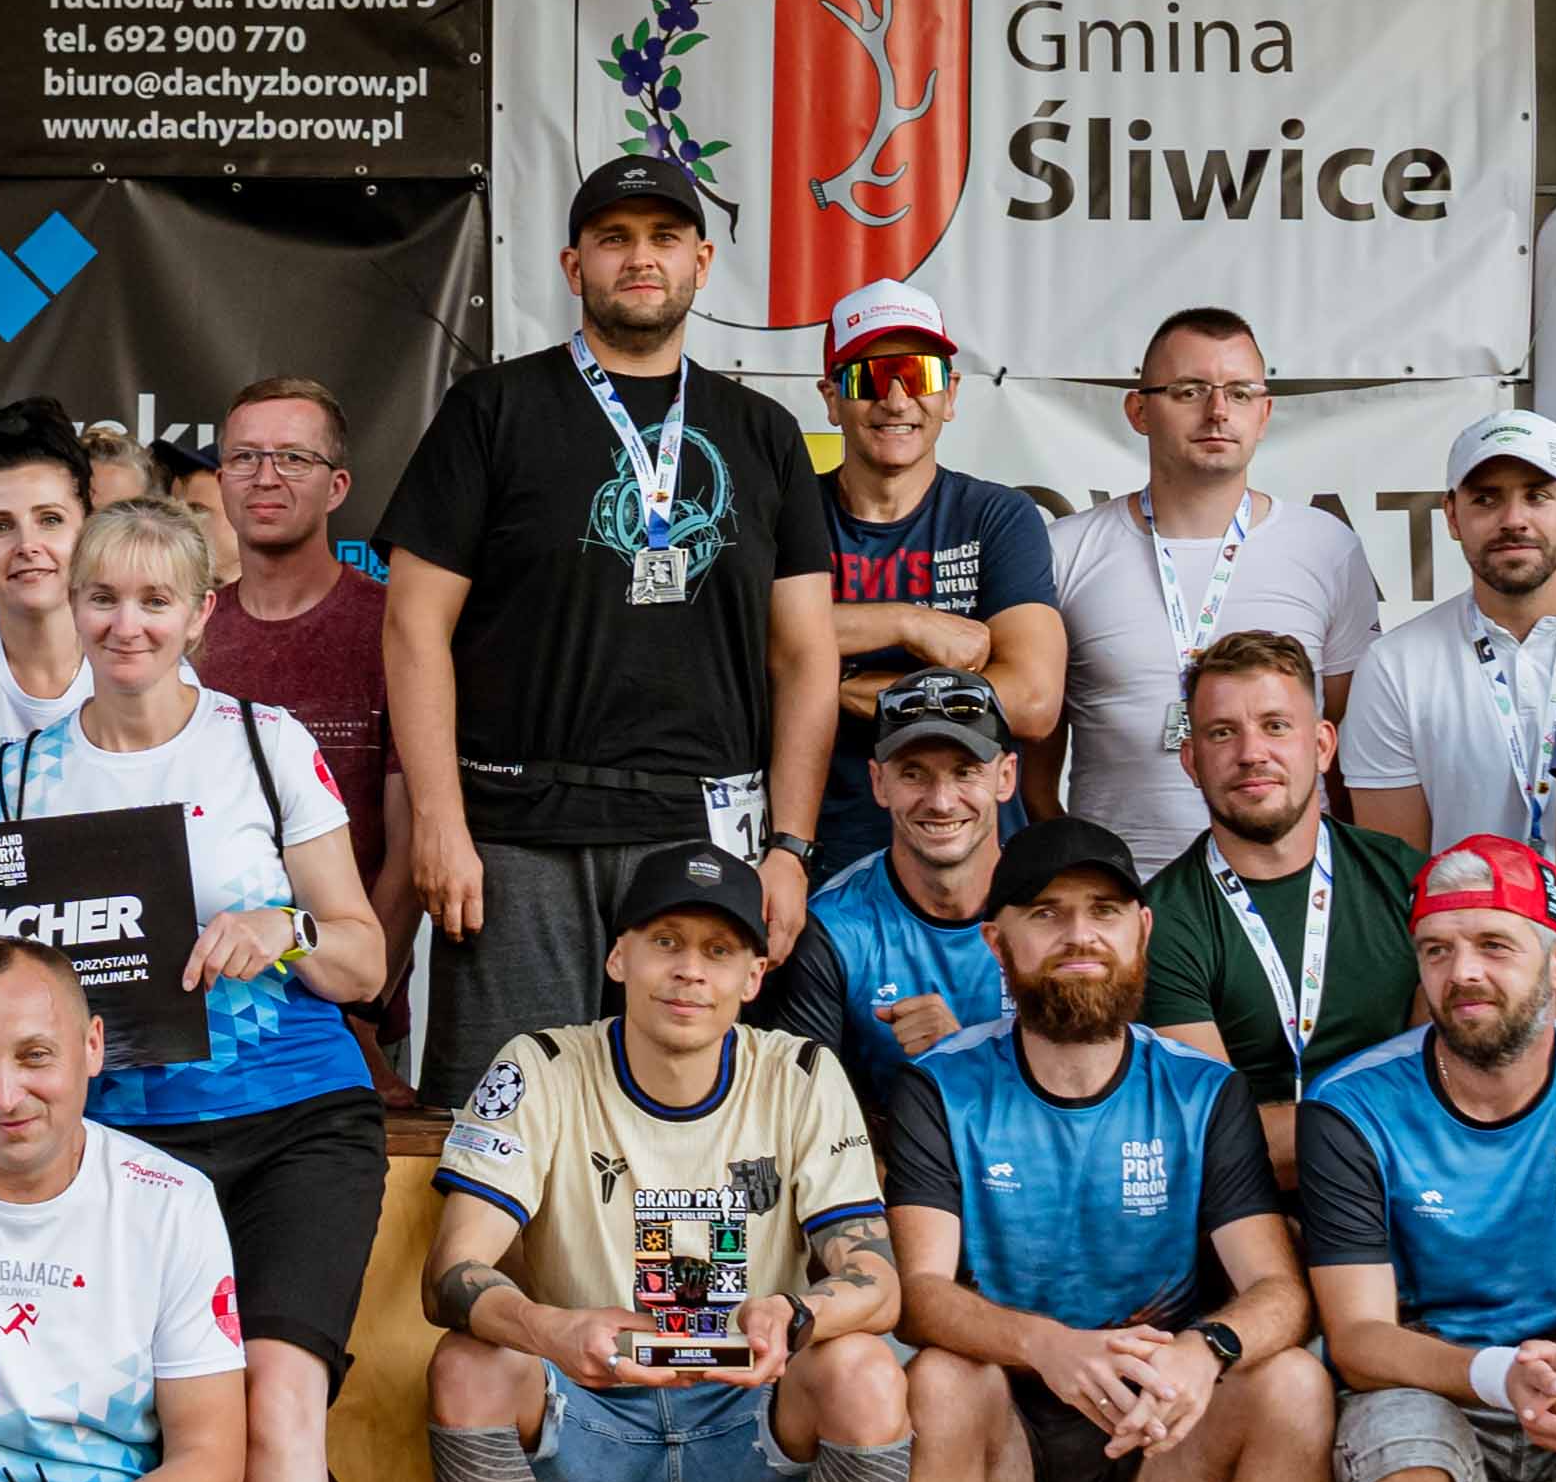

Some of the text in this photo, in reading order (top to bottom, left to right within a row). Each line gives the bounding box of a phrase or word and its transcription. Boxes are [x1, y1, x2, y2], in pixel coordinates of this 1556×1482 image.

[43, 24, 307, 54] tel. 692 900 770
[43, 66, 429, 102] biuro@dachyzborow.pl
[43, 111, 405, 146] www.dachyzborow.pl
[1005, 99, 1453, 224] Śliwice
[830, 547, 933, 603] EVI'S
[634, 1189, 691, 1208] GRAND
